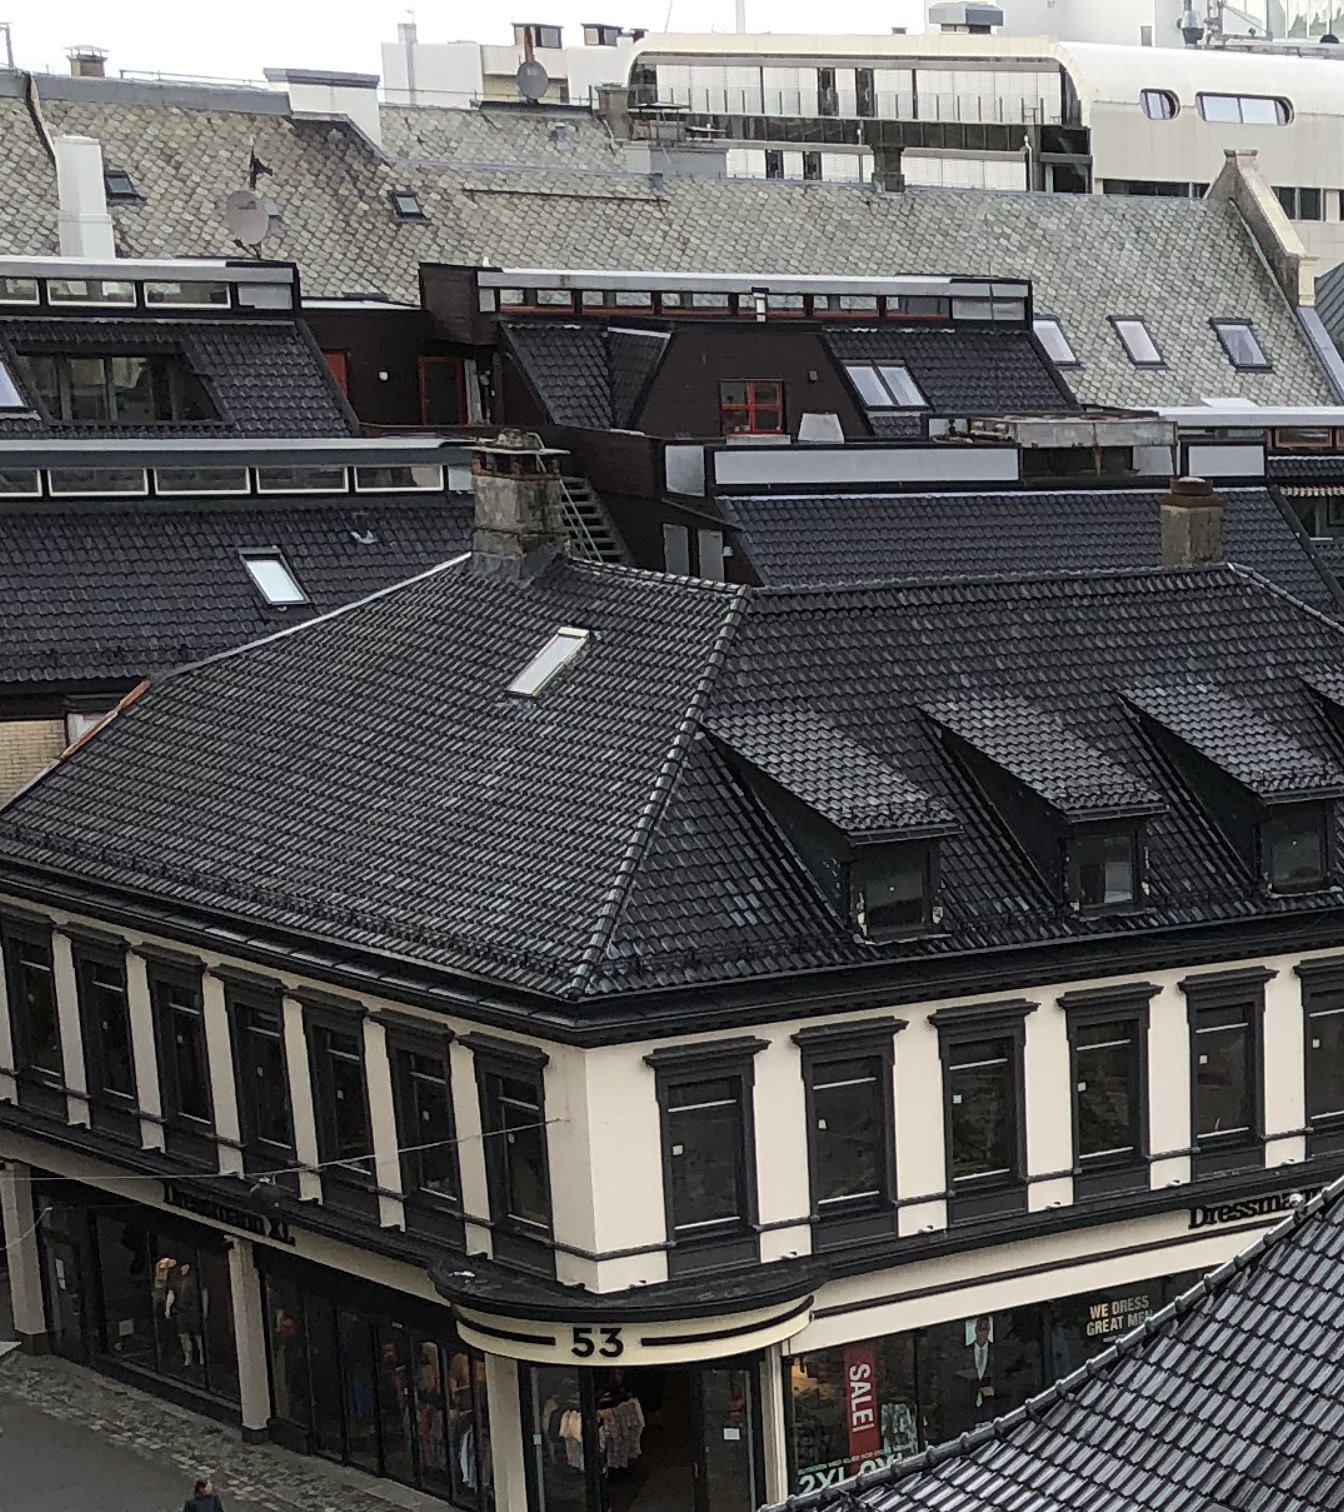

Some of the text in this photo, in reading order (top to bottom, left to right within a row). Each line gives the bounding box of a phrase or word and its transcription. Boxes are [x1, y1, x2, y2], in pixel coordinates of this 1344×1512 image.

[1089, 1295, 1150, 1319] WE DRESS
[1086, 1315, 1123, 1336] GREAT
[571, 1327, 624, 1357] 53
